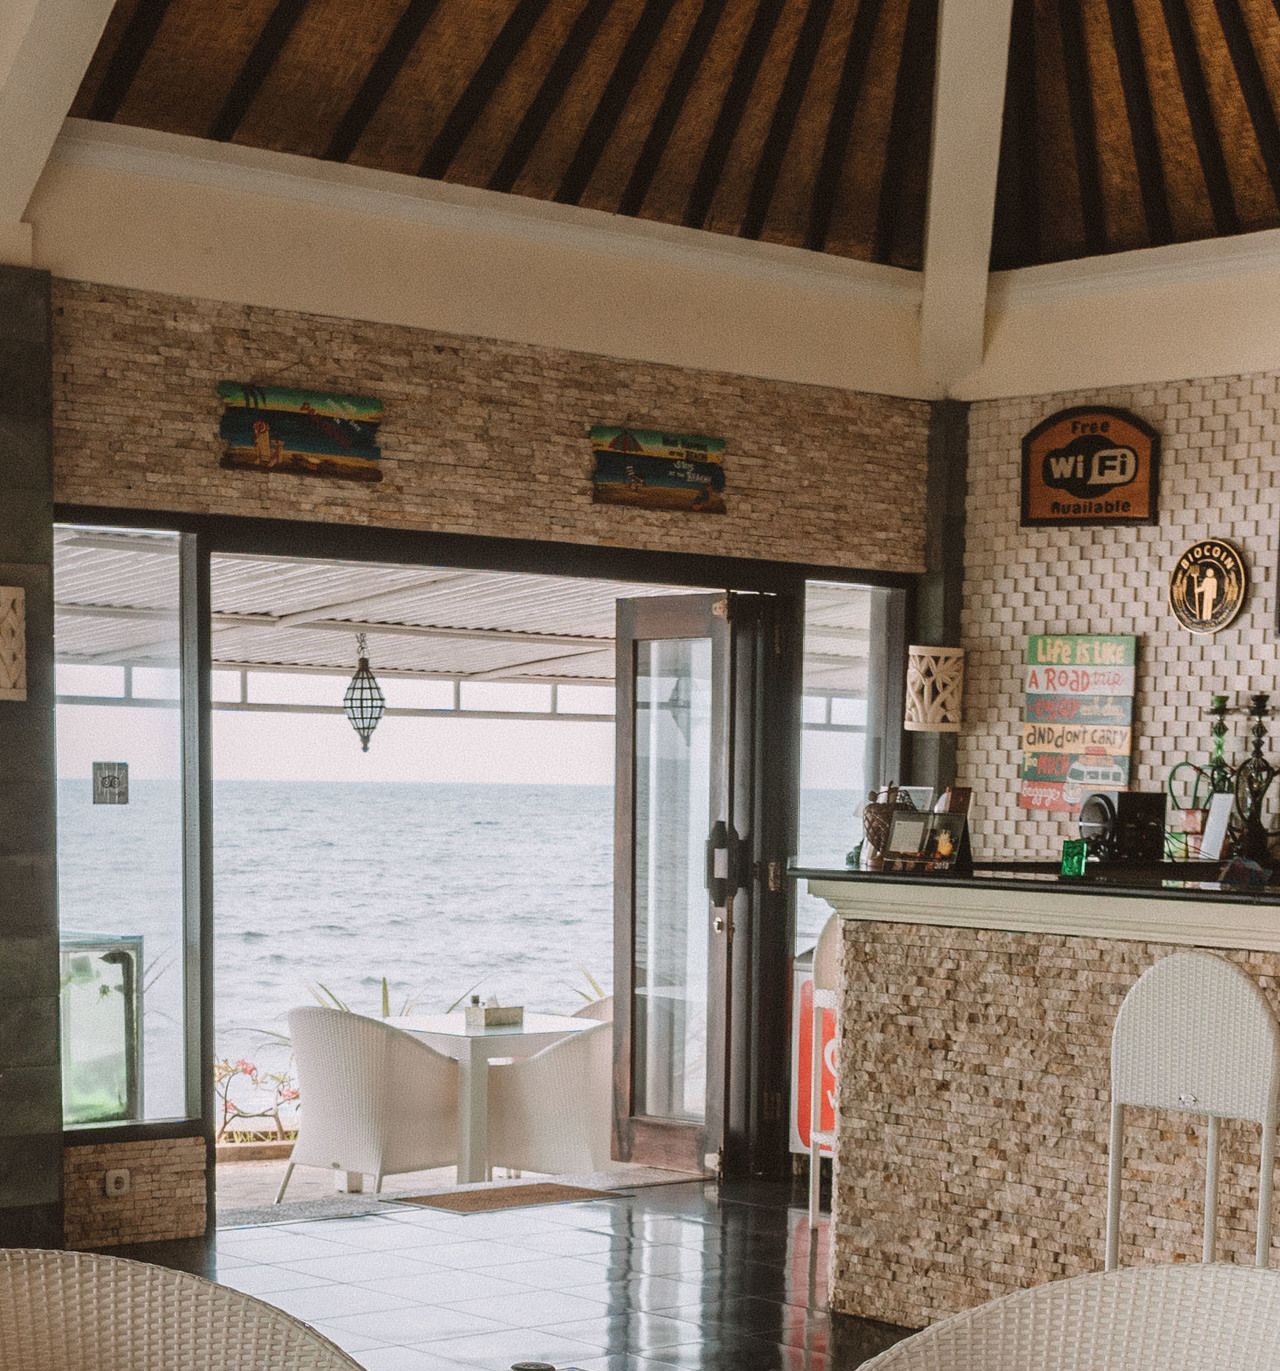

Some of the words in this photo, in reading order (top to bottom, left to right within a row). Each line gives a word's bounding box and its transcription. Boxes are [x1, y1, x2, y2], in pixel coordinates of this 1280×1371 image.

[1071, 421, 1110, 434] Free
[1051, 501, 1128, 515] Available
[1181, 545, 1234, 570] BIOCOIN
[1028, 670, 1039, 690] A
